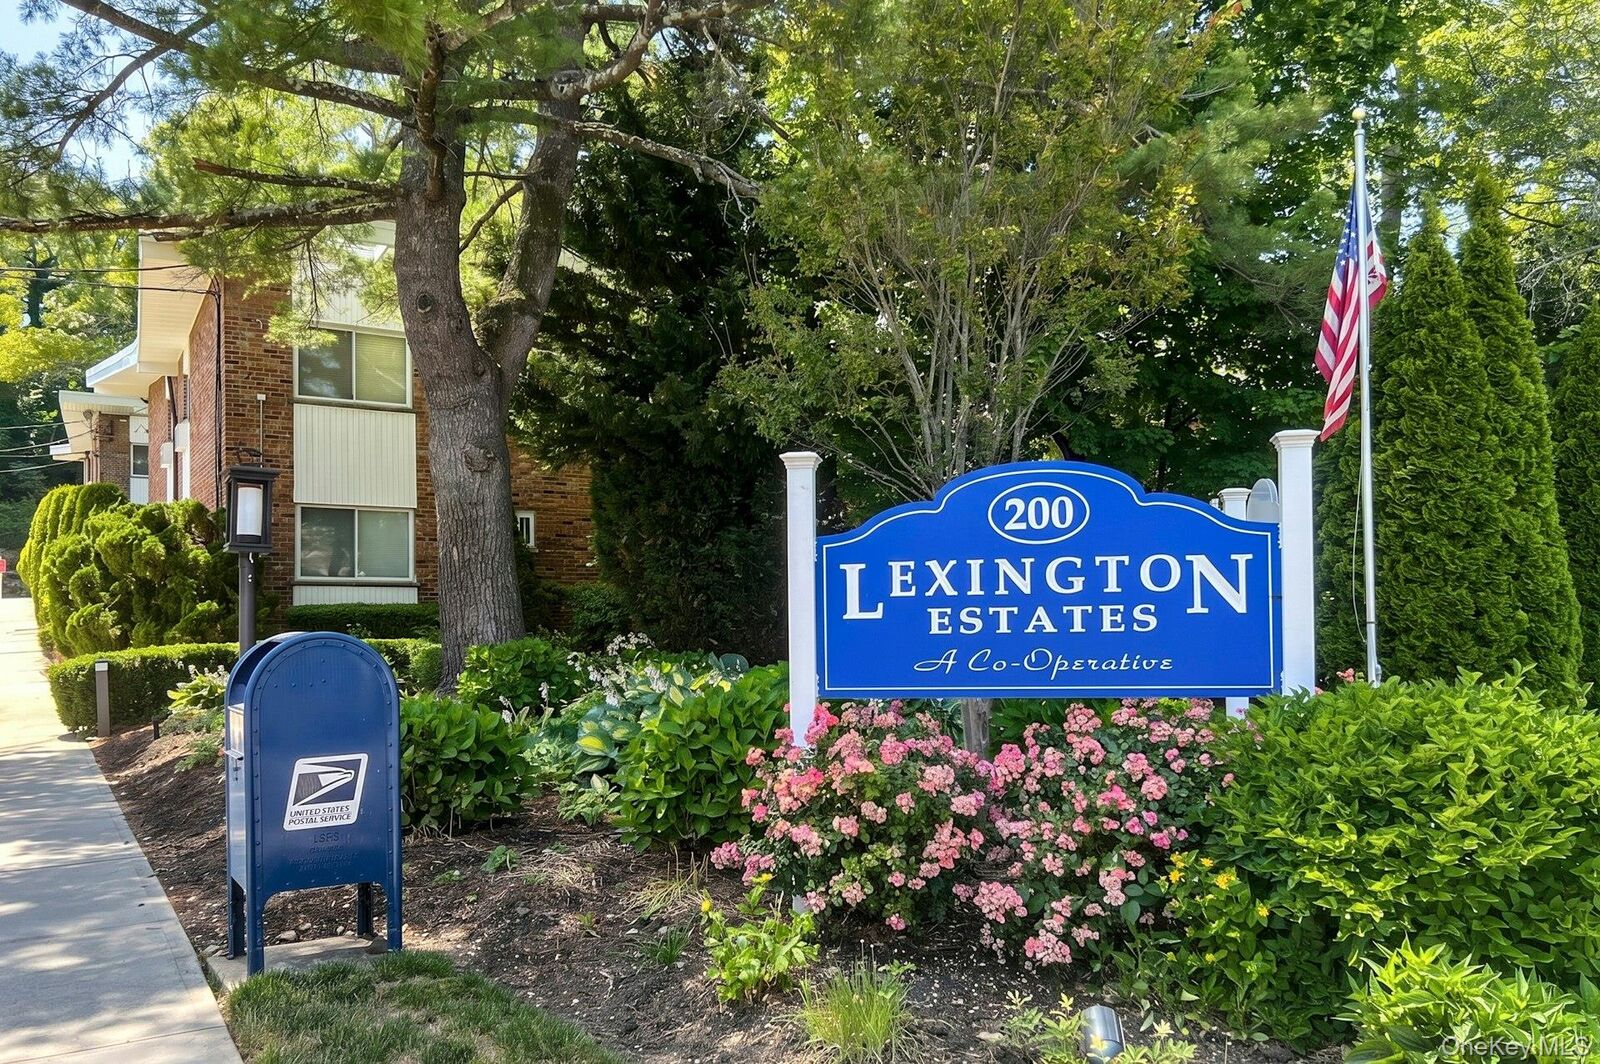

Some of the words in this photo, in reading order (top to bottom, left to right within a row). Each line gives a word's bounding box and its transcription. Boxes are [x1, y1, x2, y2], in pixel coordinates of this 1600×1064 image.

[1003, 495, 1074, 531] 200
[839, 553, 1254, 620] LEXINGTON
[927, 604, 1159, 635] ESTATES
[912, 648, 957, 674] A
[967, 647, 1174, 680] Co-Operative
[288, 816, 318, 825] POSTAL
[320, 814, 351, 822] SERVICE
[290, 808, 320, 817] UNITED
[322, 805, 350, 814] STATES
